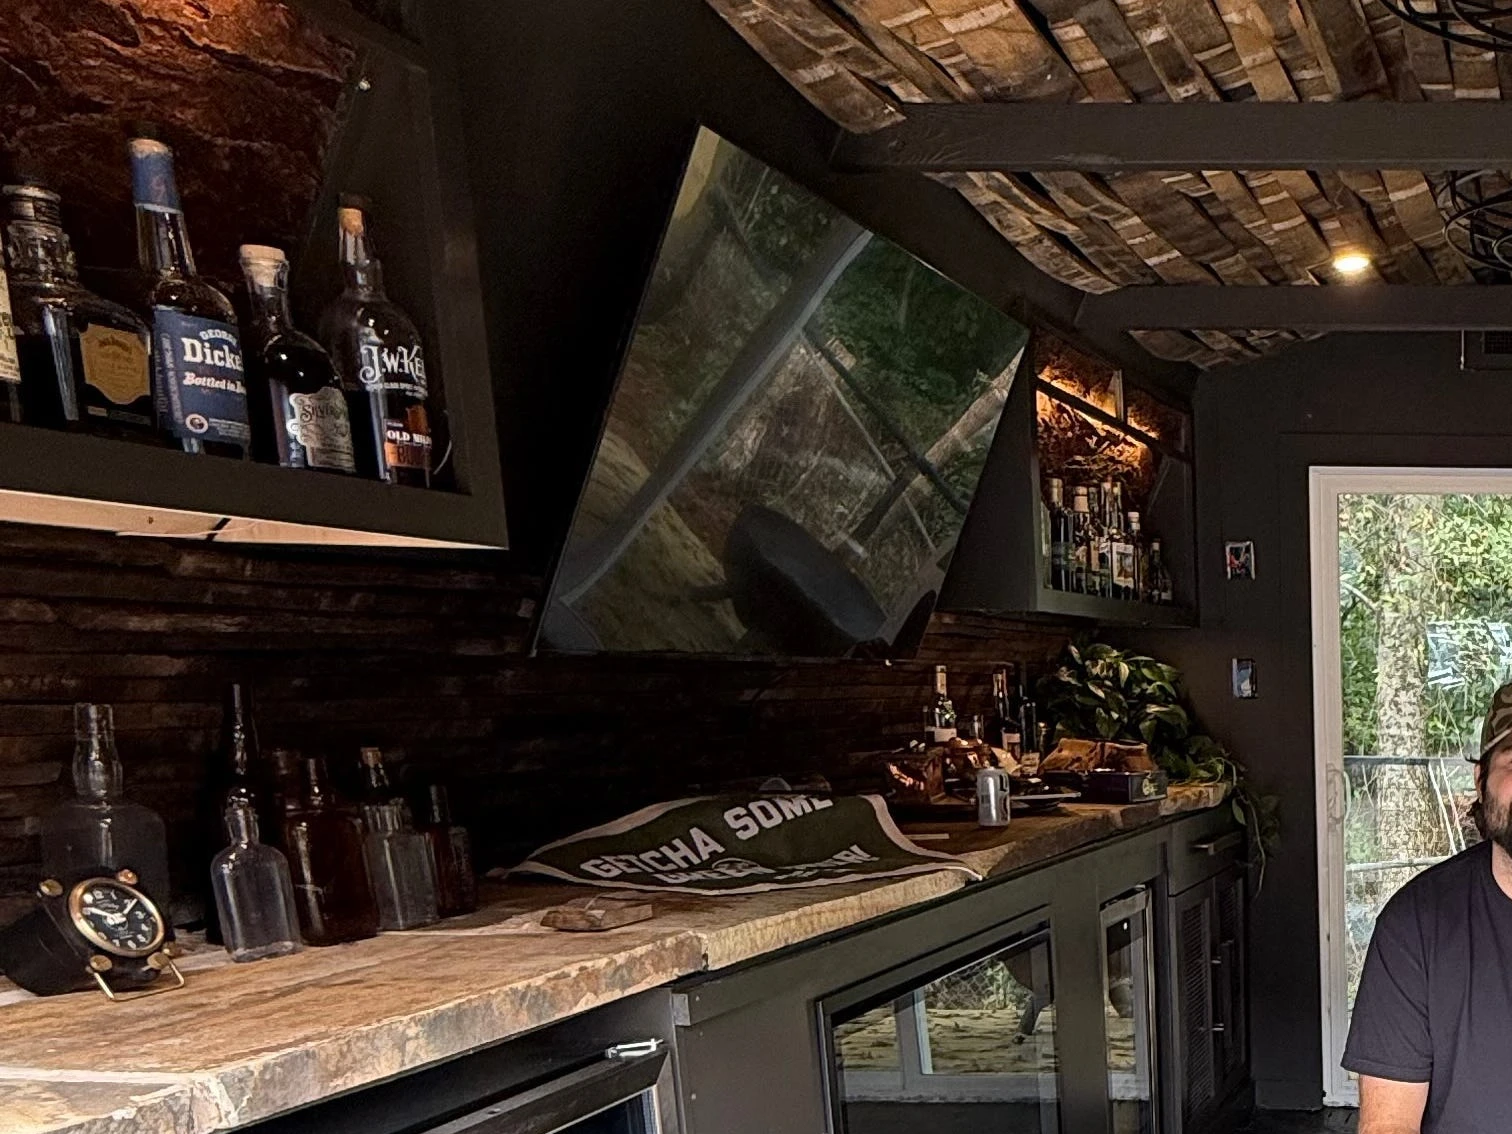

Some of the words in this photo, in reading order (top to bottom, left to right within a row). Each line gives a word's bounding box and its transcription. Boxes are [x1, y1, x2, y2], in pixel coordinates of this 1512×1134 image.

[180, 337, 245, 372] Dicke
[182, 371, 226, 391] Bottled
[387, 429, 411, 442] OLD
[580, 827, 725, 878] GETCHA
